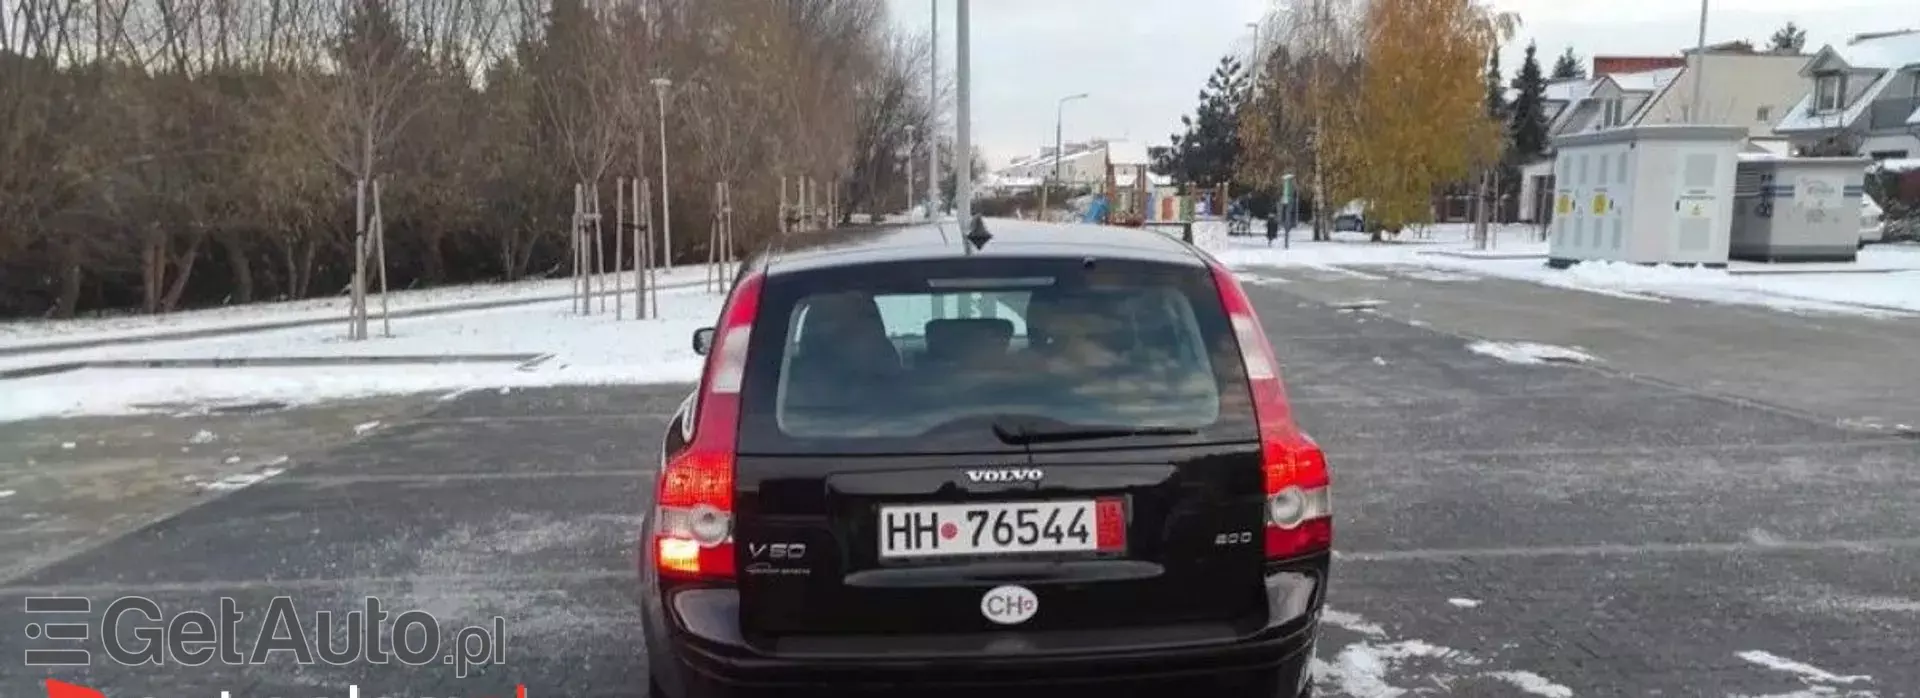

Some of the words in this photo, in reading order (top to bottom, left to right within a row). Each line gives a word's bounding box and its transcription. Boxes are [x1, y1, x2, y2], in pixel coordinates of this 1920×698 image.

[966, 468, 1043, 481] VOLVO
[967, 507, 1089, 547] 76544
[987, 595, 1022, 616] CH
